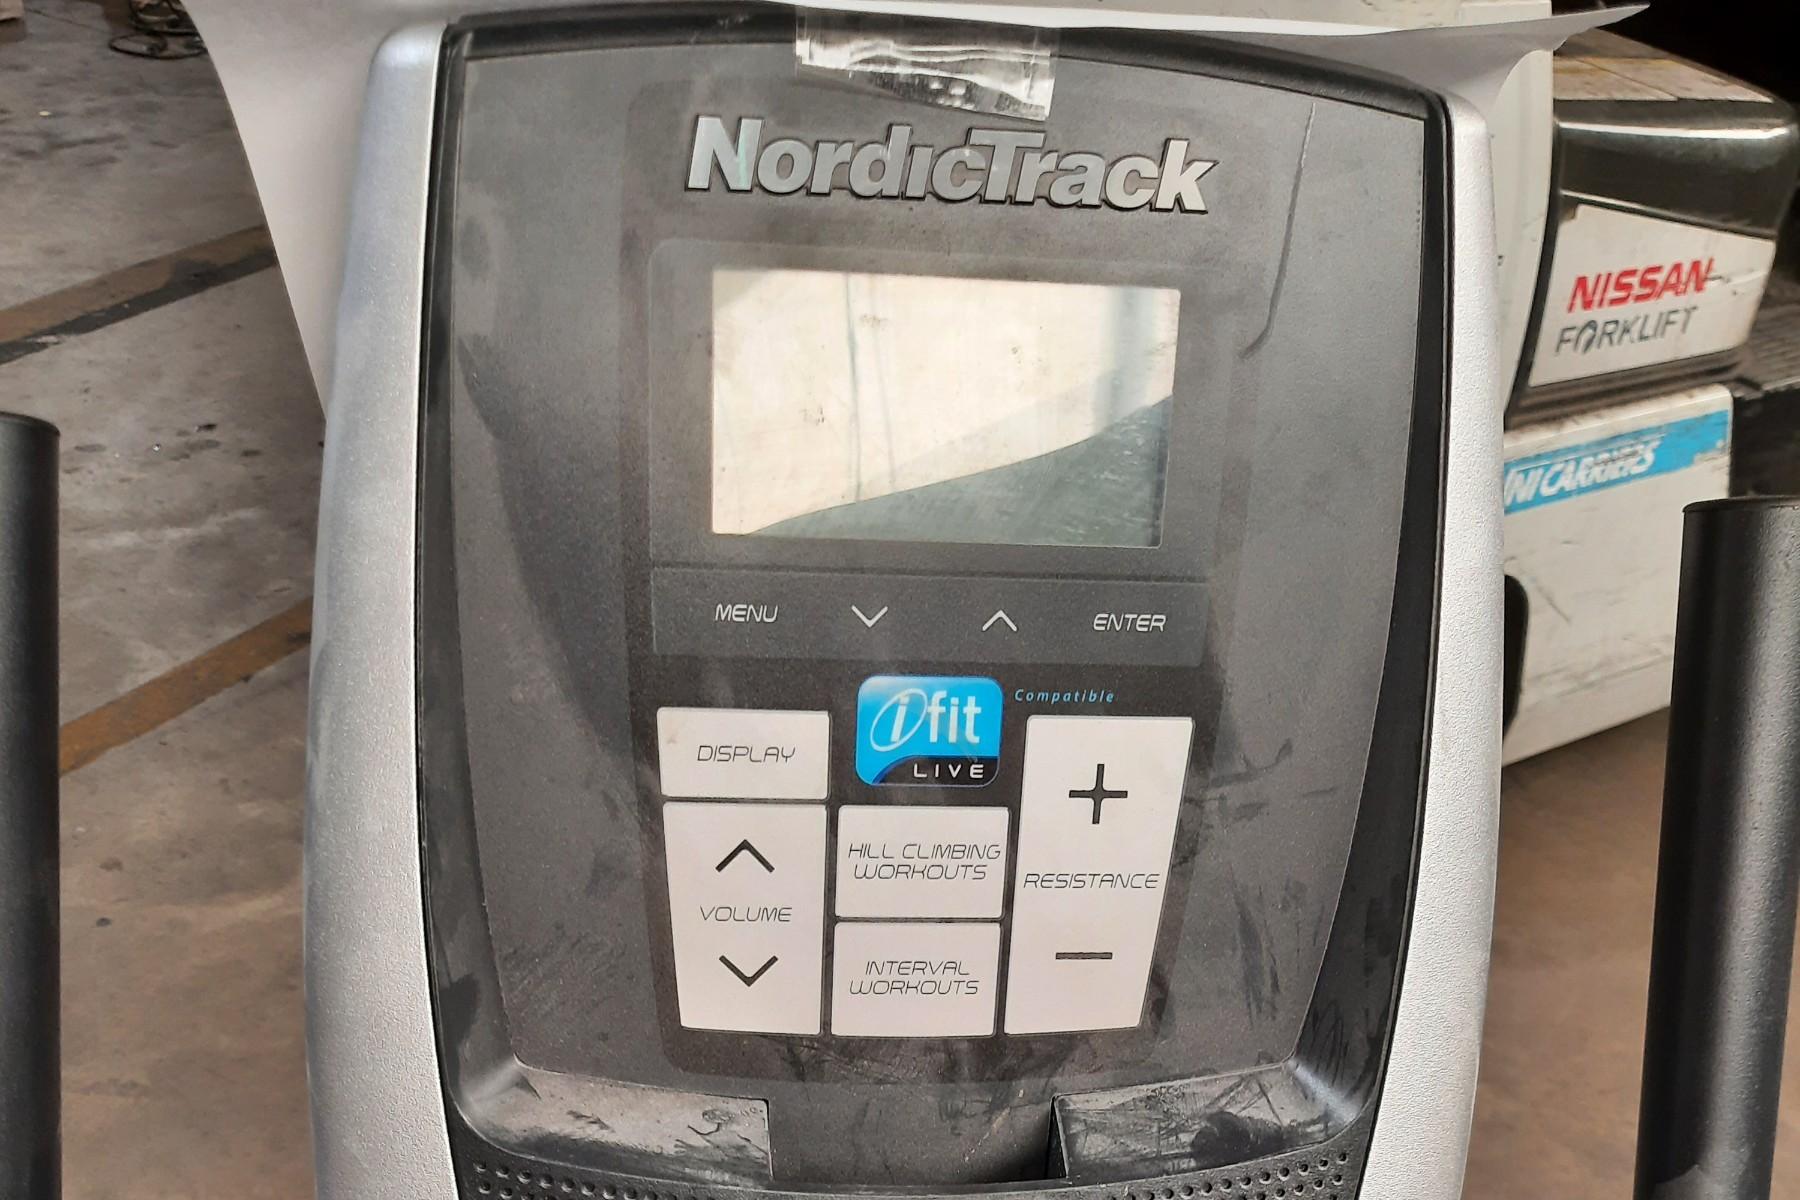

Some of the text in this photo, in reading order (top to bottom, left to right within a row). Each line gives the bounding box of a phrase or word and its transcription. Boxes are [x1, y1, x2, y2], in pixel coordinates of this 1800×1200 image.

[686, 114, 1219, 213] NordicTrack
[1568, 258, 1713, 312] NISSAN
[1556, 307, 1697, 353] FORKLIFT
[714, 603, 779, 623] MENU
[1092, 612, 1167, 633] ENTER
[1014, 688, 1115, 705] Compatible
[696, 744, 796, 764] DISPLAY
[912, 762, 984, 779] LIVE
[848, 842, 1002, 861] HILL CLIMBING
[853, 863, 988, 881] WORKOUTS
[1023, 872, 1160, 890] RESISTANCE
[700, 906, 792, 923] VOLUME
[864, 960, 971, 977] INTERVAL
[848, 979, 980, 997] WORKOUTS
